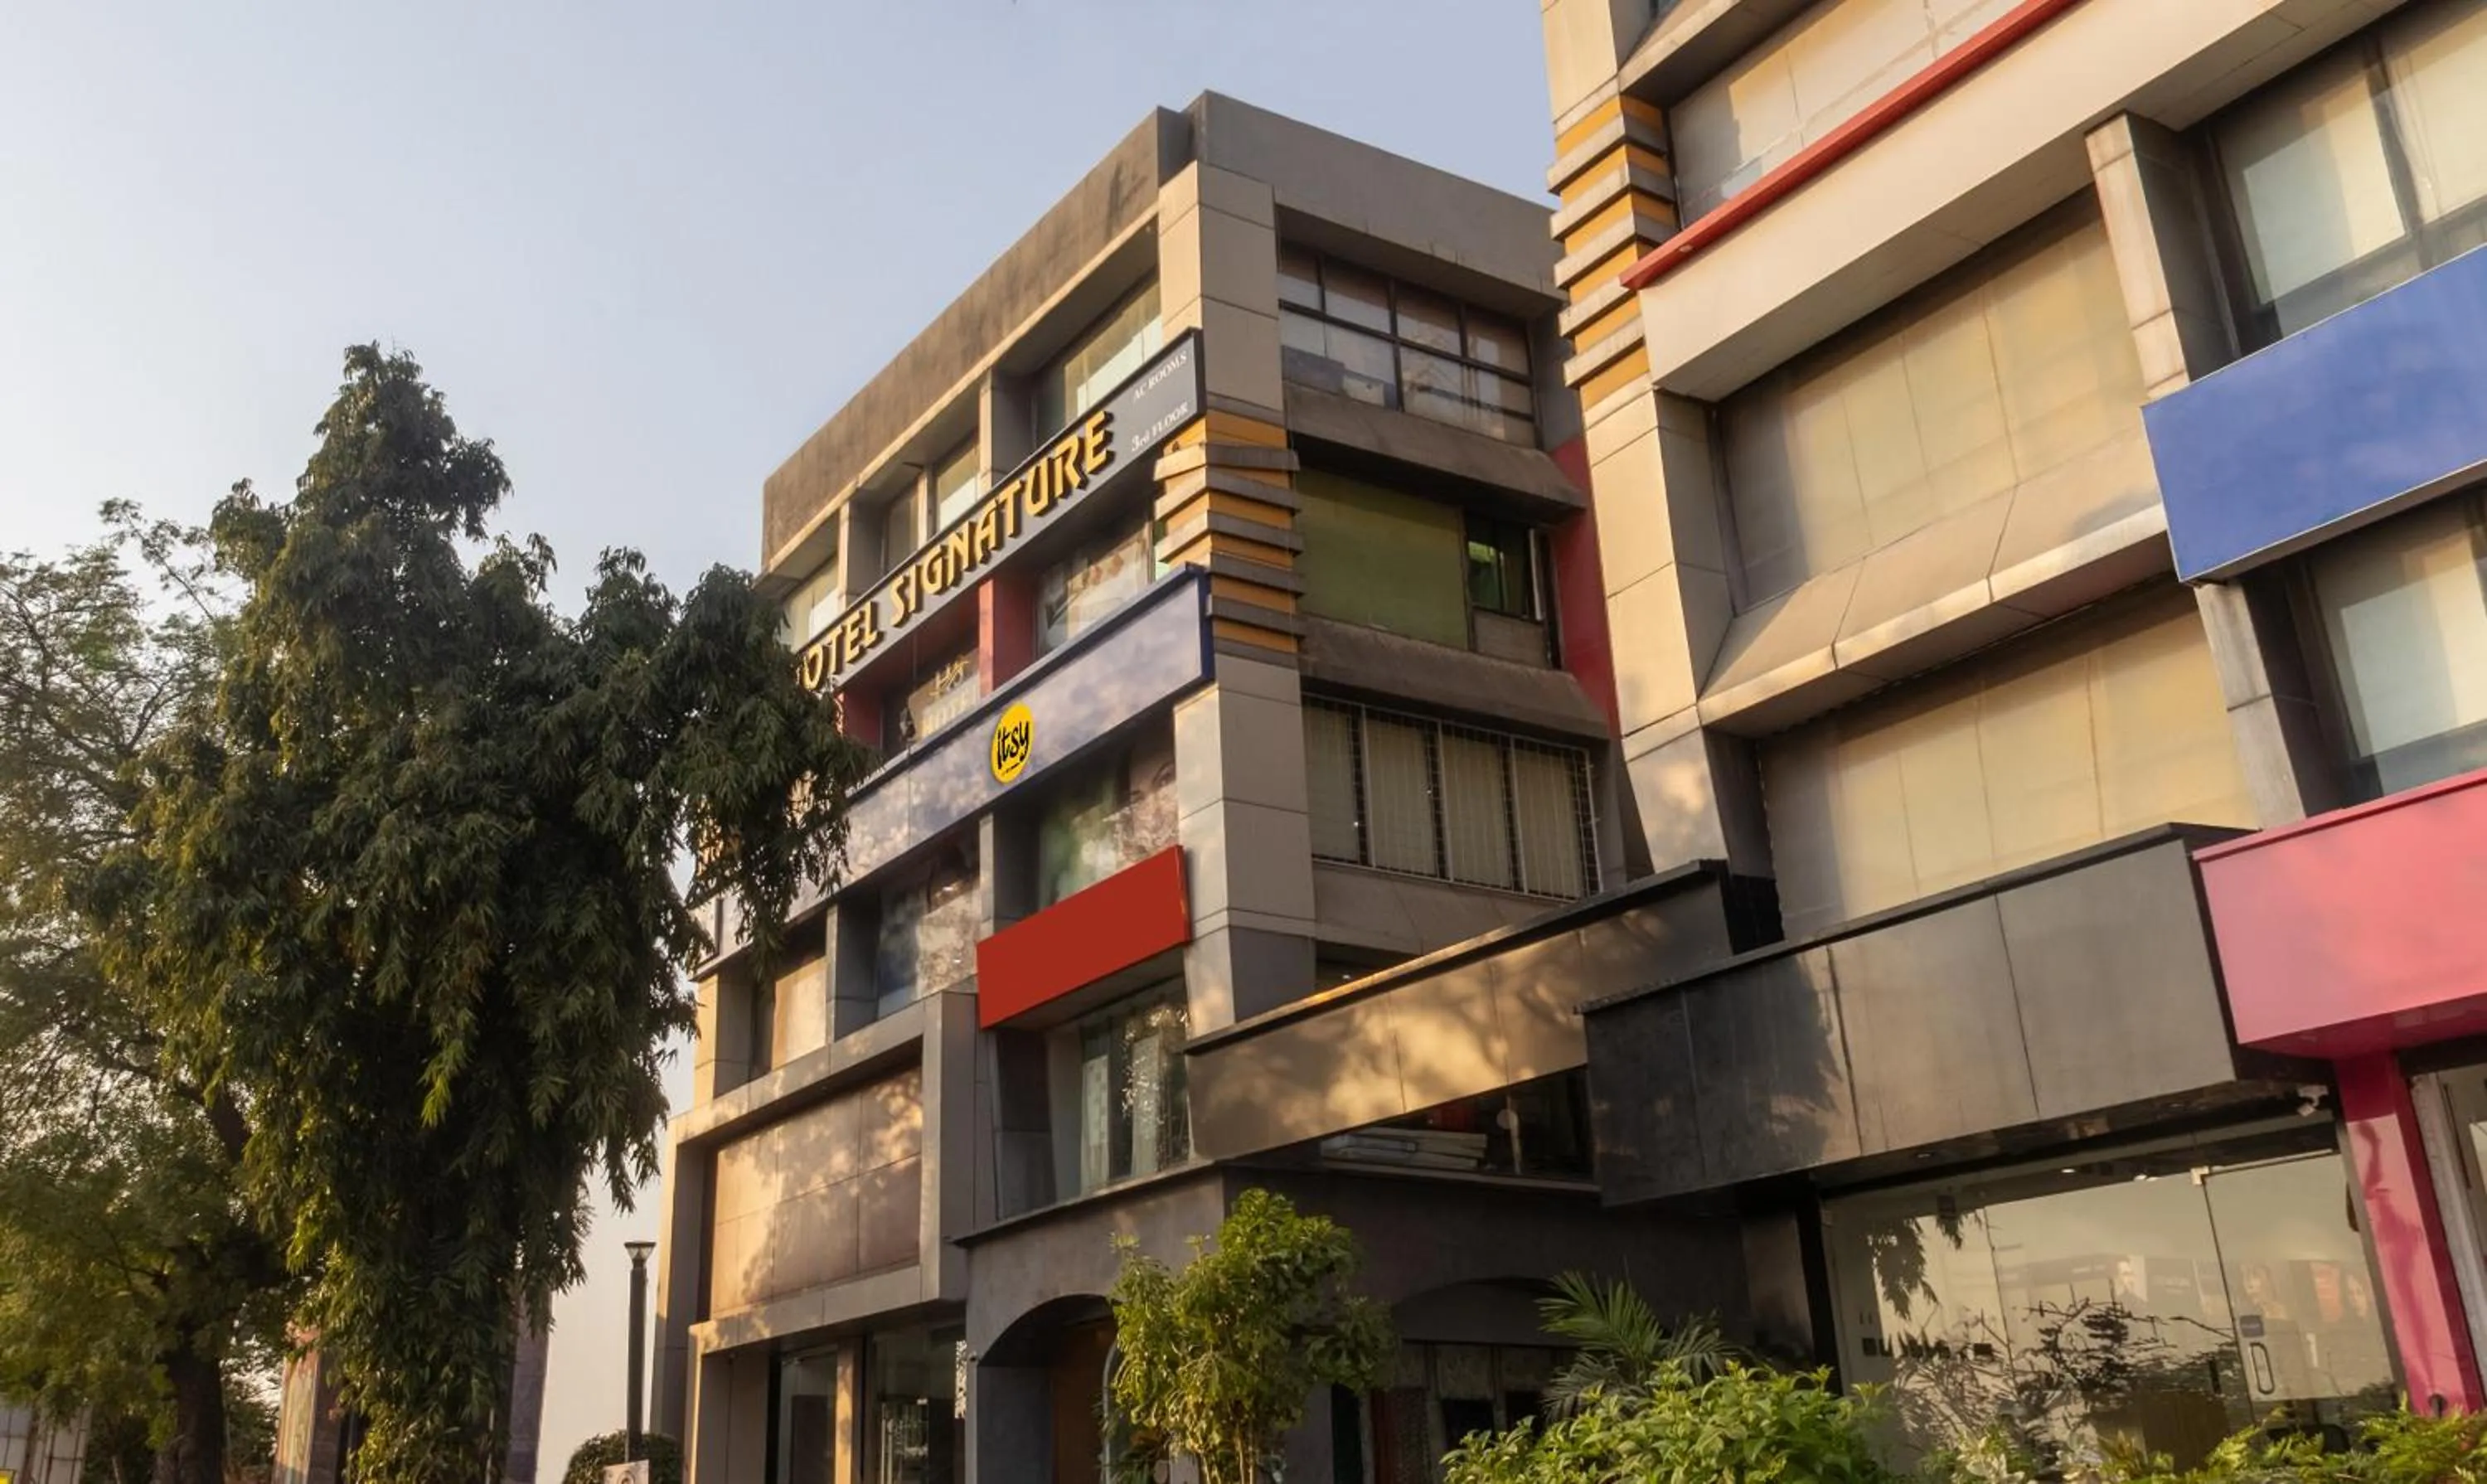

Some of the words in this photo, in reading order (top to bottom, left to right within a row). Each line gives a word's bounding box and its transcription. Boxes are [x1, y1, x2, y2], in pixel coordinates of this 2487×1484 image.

[1147, 350, 1187, 390] ROOMS
[1151, 401, 1188, 437] FLOOR
[802, 600, 883, 691] OTEL
[890, 410, 1115, 628] SIGNATURE
[997, 720, 1029, 770] itsy
